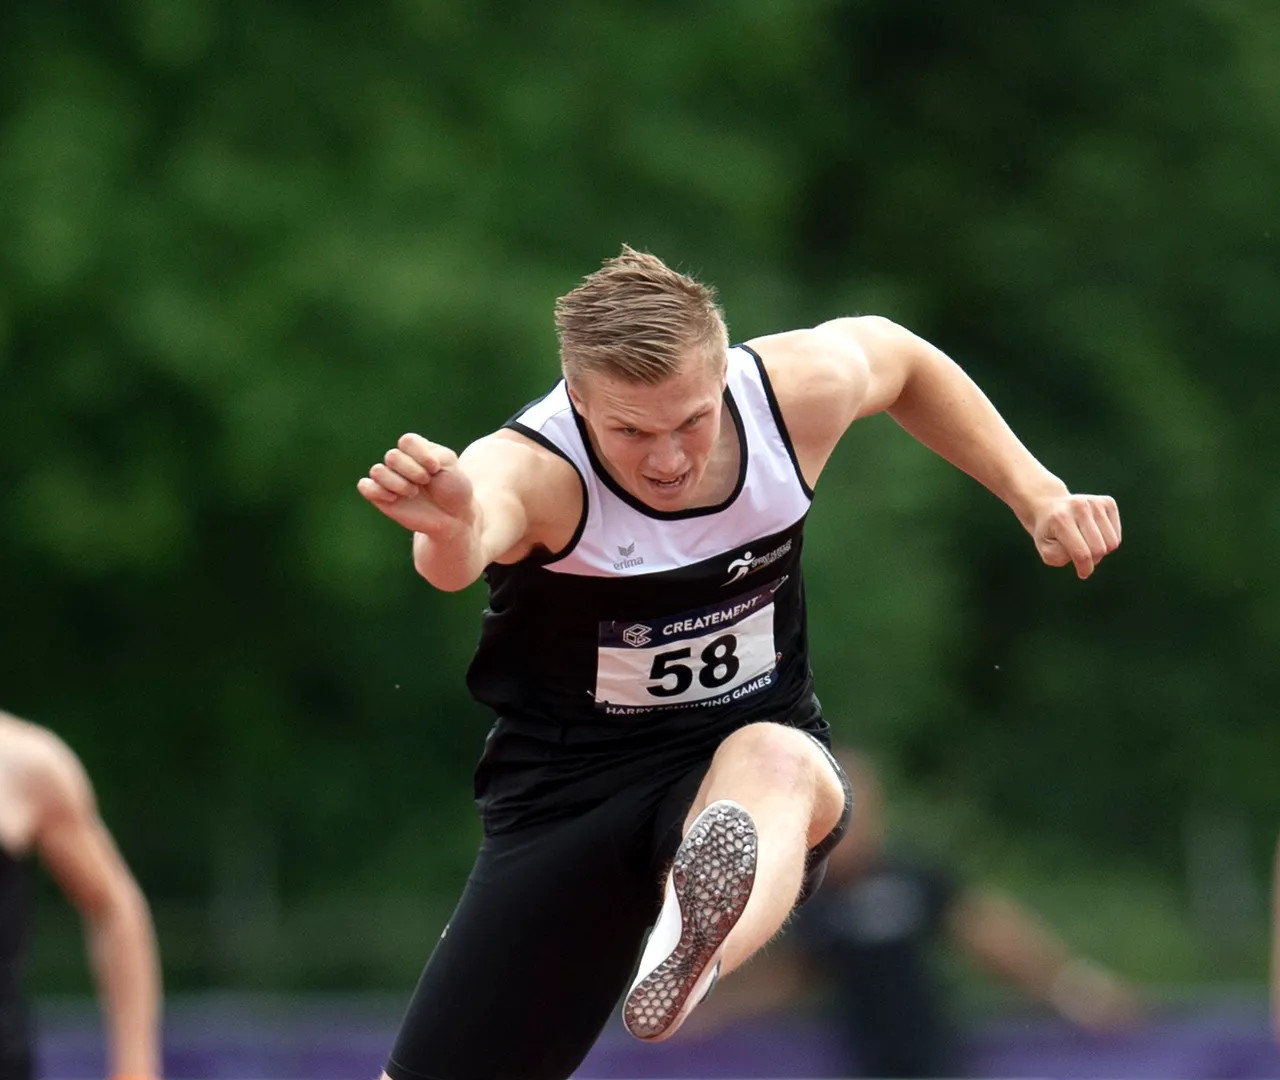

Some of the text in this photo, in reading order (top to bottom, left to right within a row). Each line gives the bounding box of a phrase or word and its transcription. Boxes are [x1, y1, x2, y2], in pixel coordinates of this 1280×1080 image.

[613, 557, 644, 571] erima
[662, 596, 759, 636] CREATEMENT
[646, 633, 740, 698] 58
[732, 674, 772, 699] GAMES
